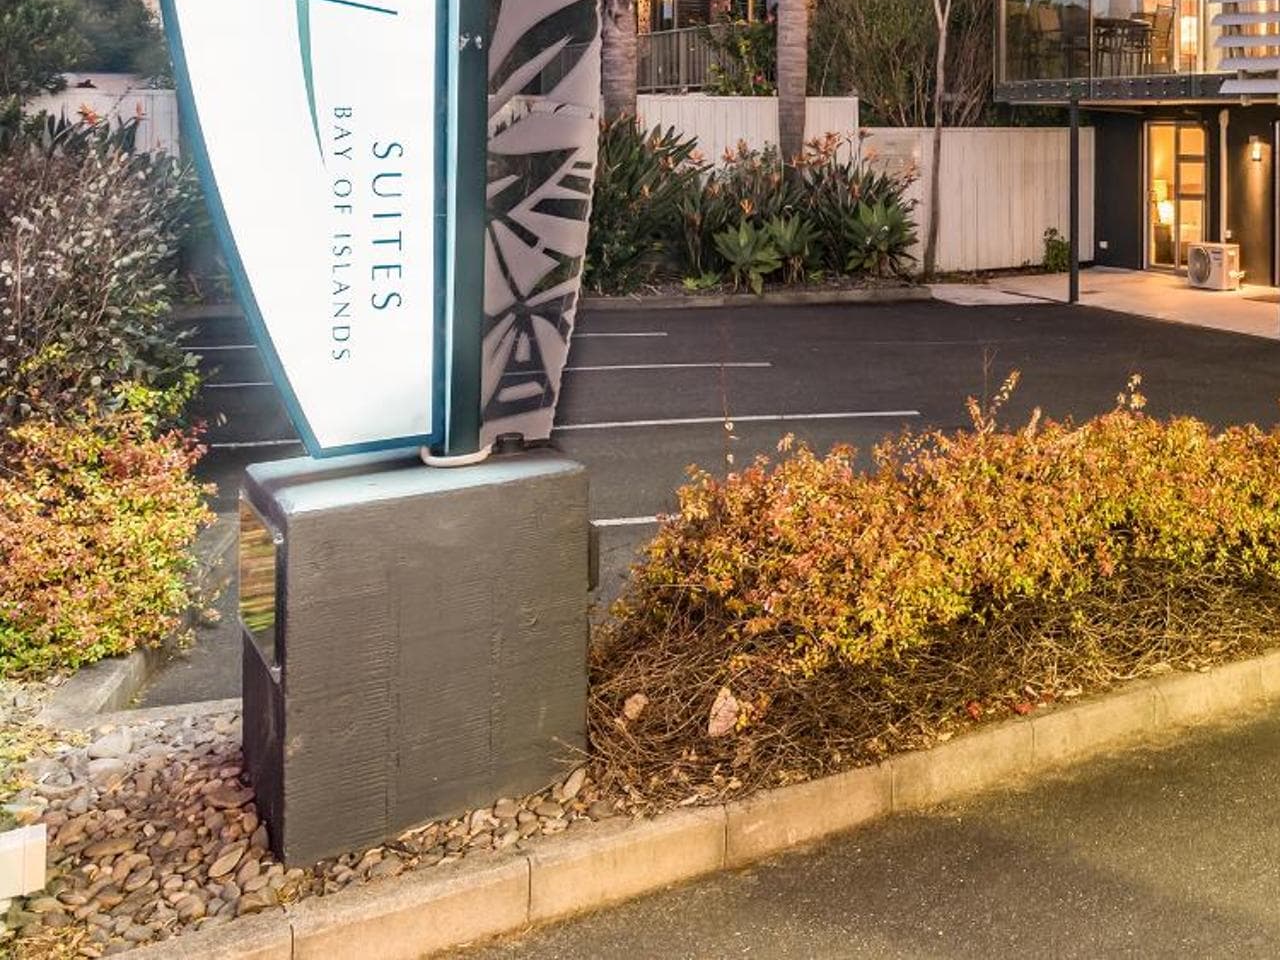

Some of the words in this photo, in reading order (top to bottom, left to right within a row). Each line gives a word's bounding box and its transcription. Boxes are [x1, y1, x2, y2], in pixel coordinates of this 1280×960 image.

[333, 107, 353, 161] BAY
[333, 179, 353, 214] OF
[371, 142, 404, 311] SUITES
[332, 230, 352, 361] ISLANDS
